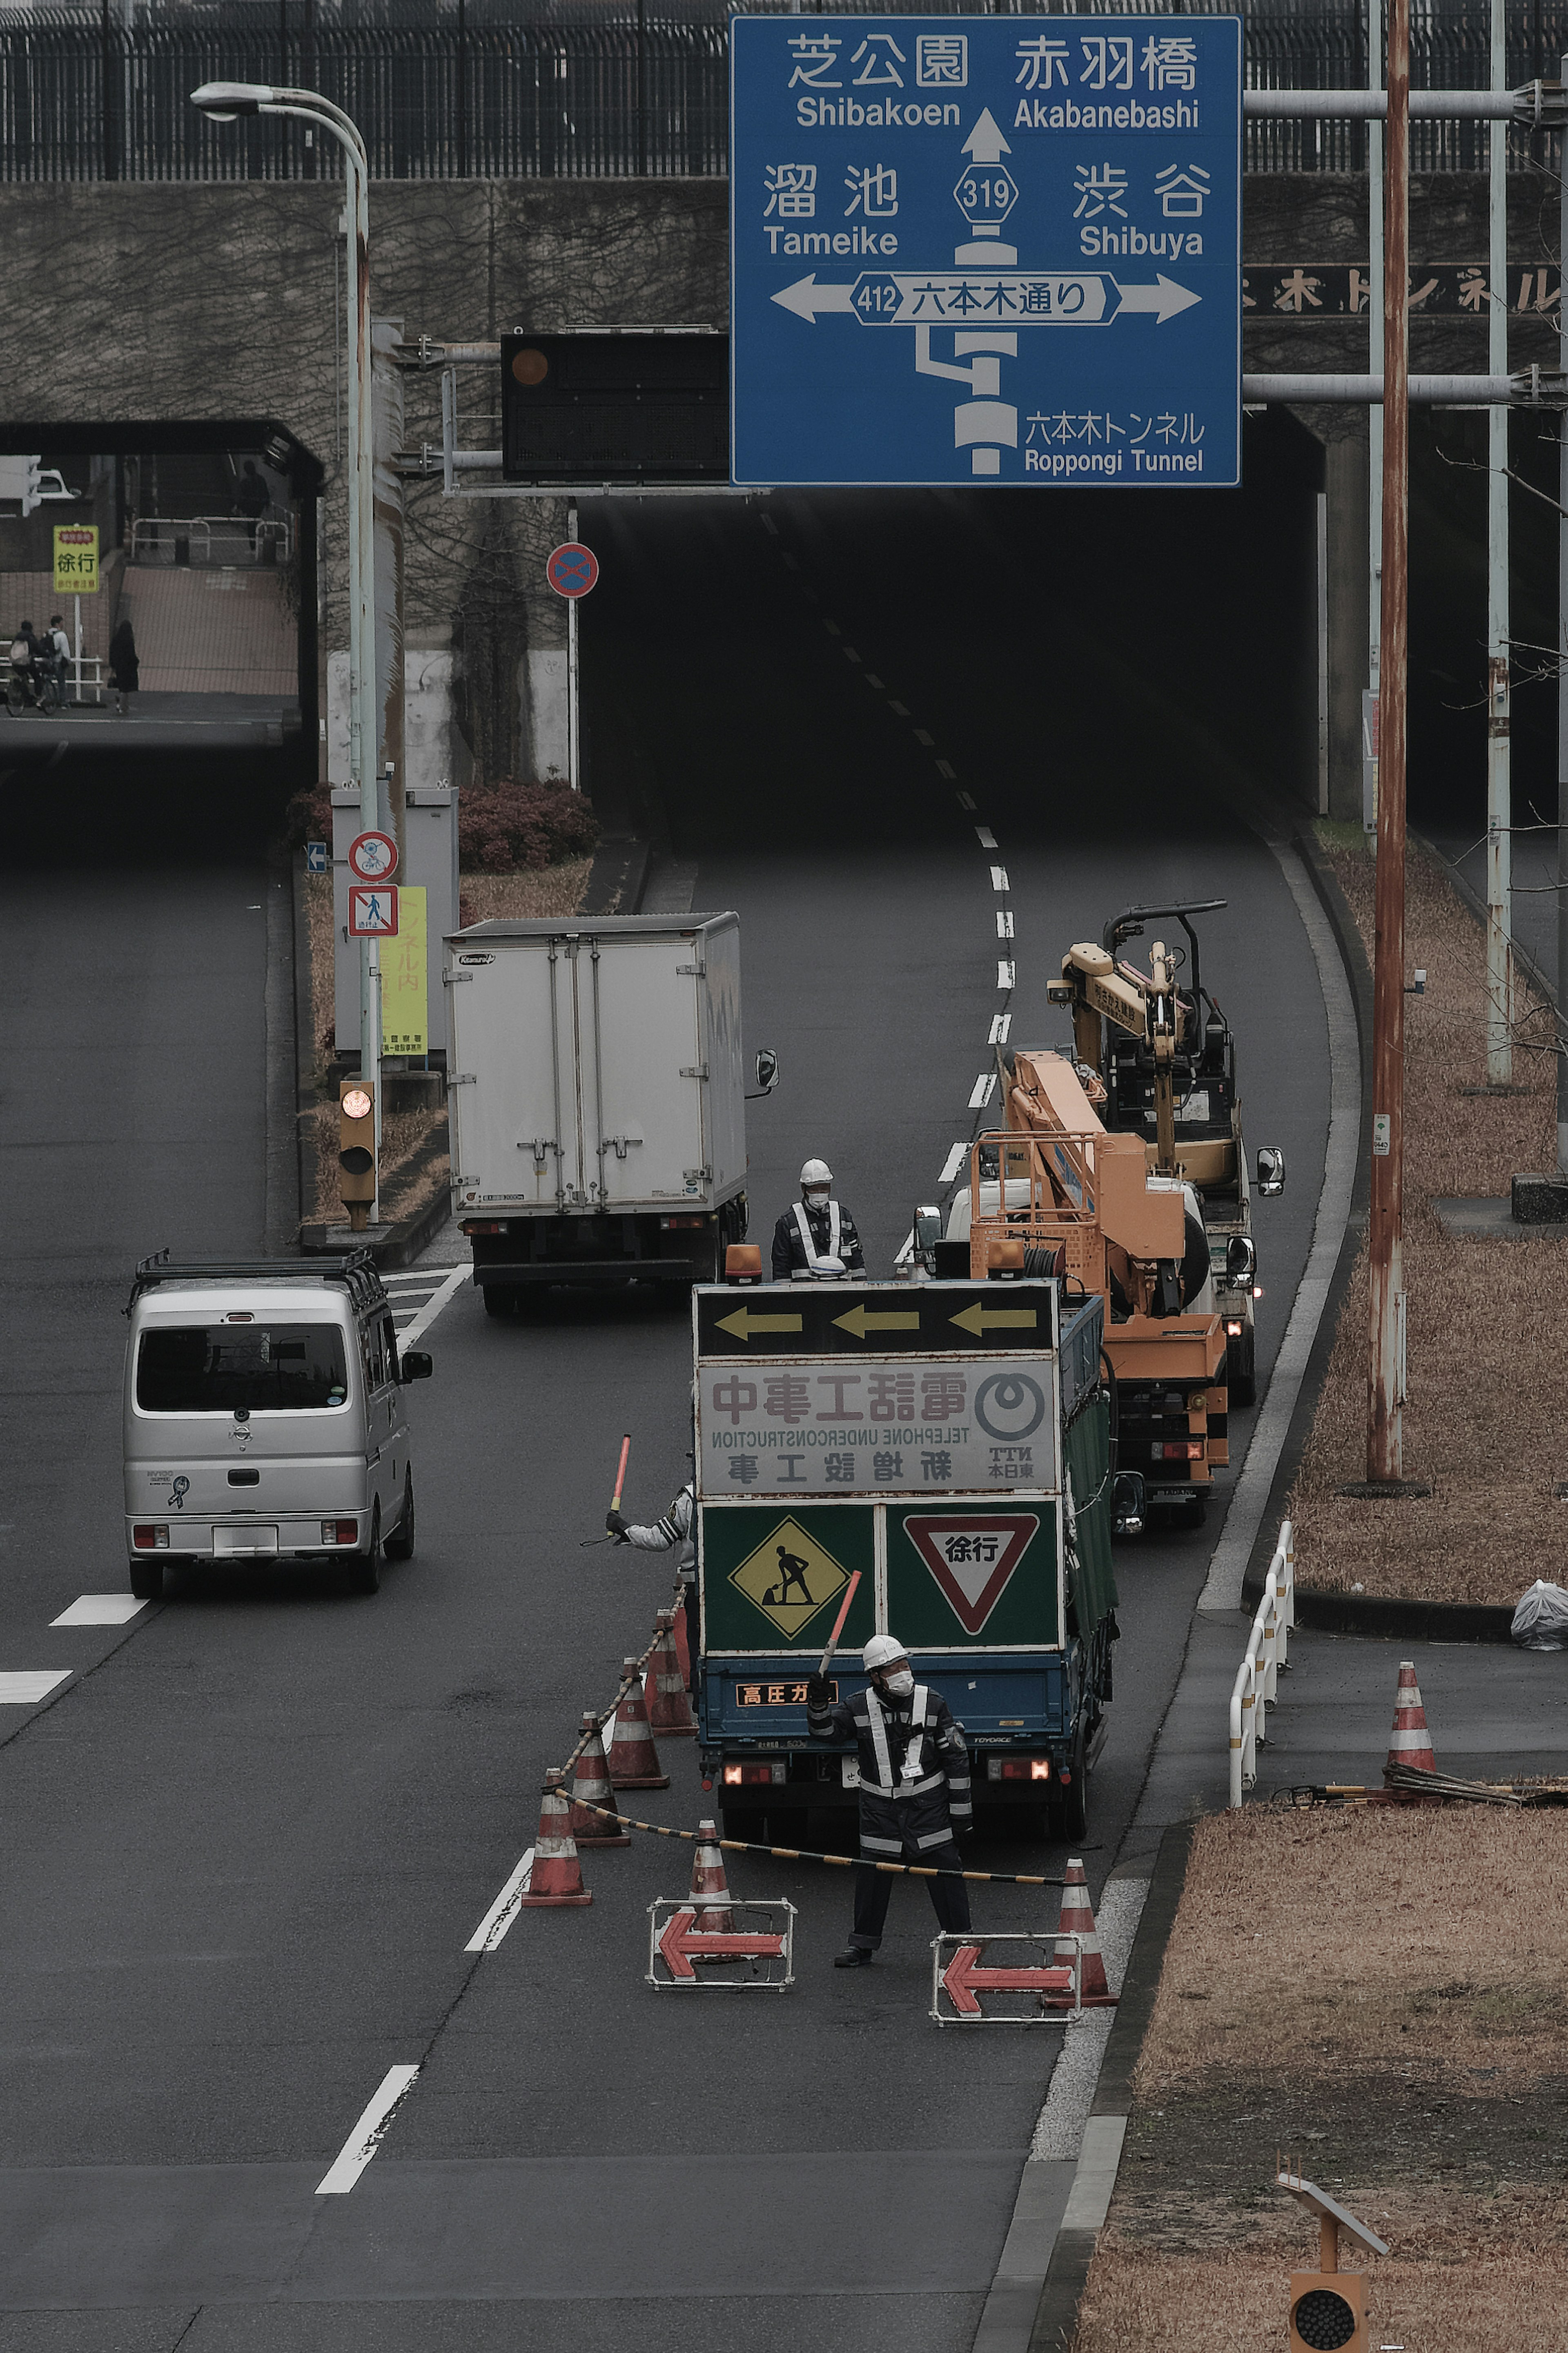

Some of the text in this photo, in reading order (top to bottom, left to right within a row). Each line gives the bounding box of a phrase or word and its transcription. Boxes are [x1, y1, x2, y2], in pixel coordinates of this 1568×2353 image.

[787, 33, 968, 88] 芝公園
[1015, 35, 1197, 91] 赤羽橋
[796, 97, 960, 127] Shibakoen
[1014, 99, 1200, 129] Akabanebashi
[763, 163, 898, 218] 溜池
[963, 179, 1007, 209] 319
[1073, 163, 1212, 219] 渋谷
[763, 226, 899, 255] Tameike
[1080, 227, 1203, 261] Shibuya
[857, 285, 896, 312] 412
[912, 282, 1085, 316] 六本木通り
[1025, 410, 1205, 446] 六本木トンネル
[1025, 450, 1203, 476] Roppongi Tunnel
[58, 553, 95, 573] 徐行
[945, 1536, 998, 1563] 徐行
